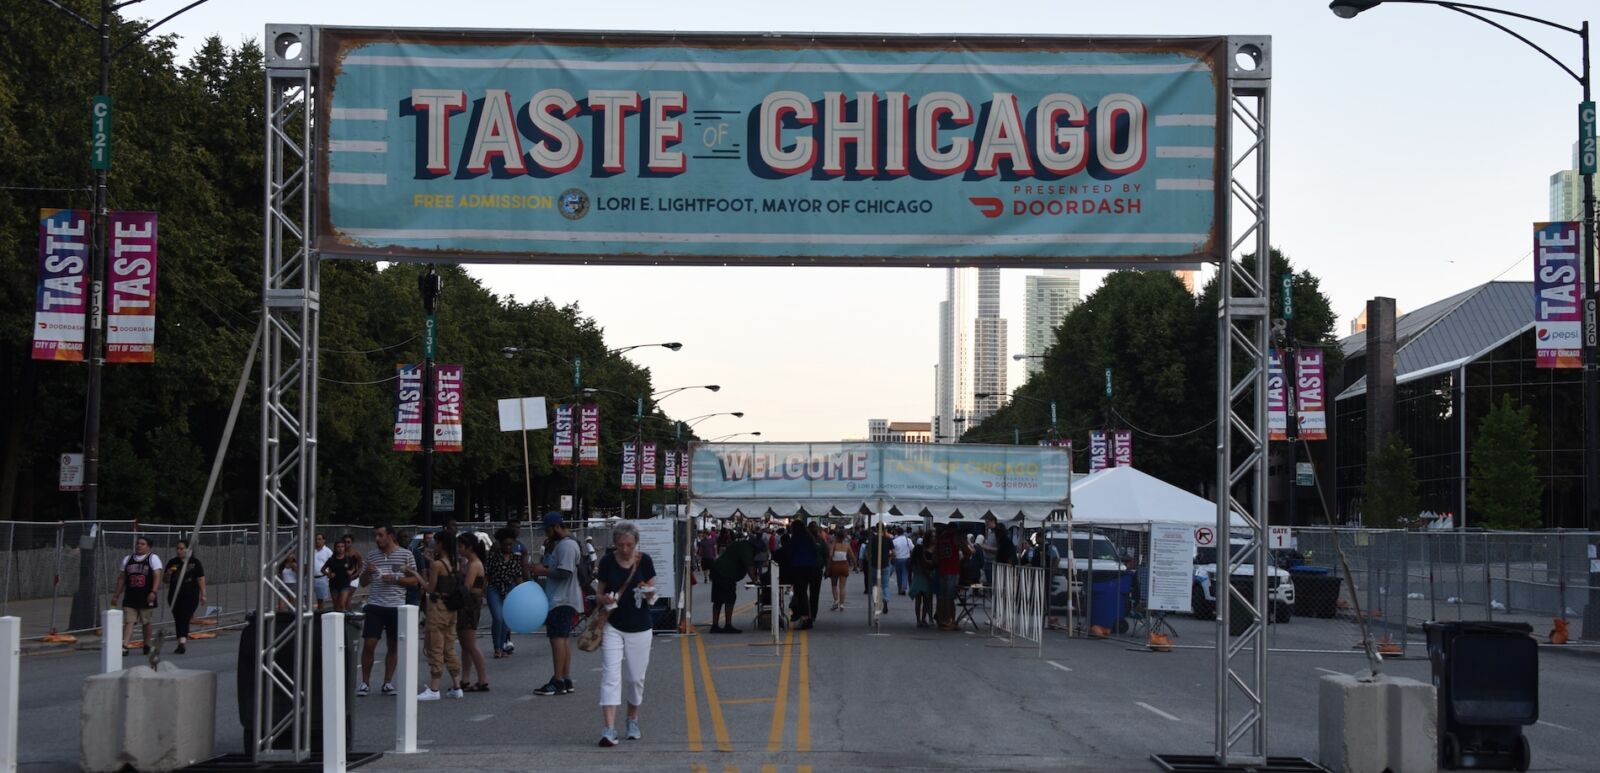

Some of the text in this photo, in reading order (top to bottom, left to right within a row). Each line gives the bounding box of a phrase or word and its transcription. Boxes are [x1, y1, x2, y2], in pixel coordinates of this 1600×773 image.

[94, 102, 107, 162] C121
[402, 88, 1147, 180] TASTE OF CHICAGO
[1582, 108, 1595, 167] C120
[413, 194, 454, 209] FREE
[459, 194, 553, 209] ADMISSION
[597, 197, 636, 211] LORI
[640, 197, 654, 211] E.
[657, 197, 758, 214] LIGHTFOOT,
[761, 198, 822, 213] MAYOR
[826, 199, 851, 213] OF
[854, 199, 933, 214] CHICAGO
[1012, 197, 1142, 216] DOORDASH
[1013, 182, 1141, 195] PRESENTED BY
[43, 218, 86, 311] TASTE
[113, 221, 153, 313] TASTE
[1539, 229, 1576, 320] TASTE
[92, 281, 101, 327] C121
[1283, 278, 1292, 314] C130
[1552, 330, 1579, 340] pepsi
[1587, 300, 1596, 345] C120
[398, 369, 421, 422] TASTE
[437, 370, 460, 423] TASTE
[1298, 354, 1322, 411] TASTE
[556, 408, 572, 445] TASTE
[581, 408, 597, 446] TASTE
[623, 445, 636, 474] TASTE
[643, 445, 656, 474] TASTE
[717, 451, 868, 482] WELCOME
[1091, 433, 1106, 470] TASTE
[1277, 535, 1282, 546] 1
